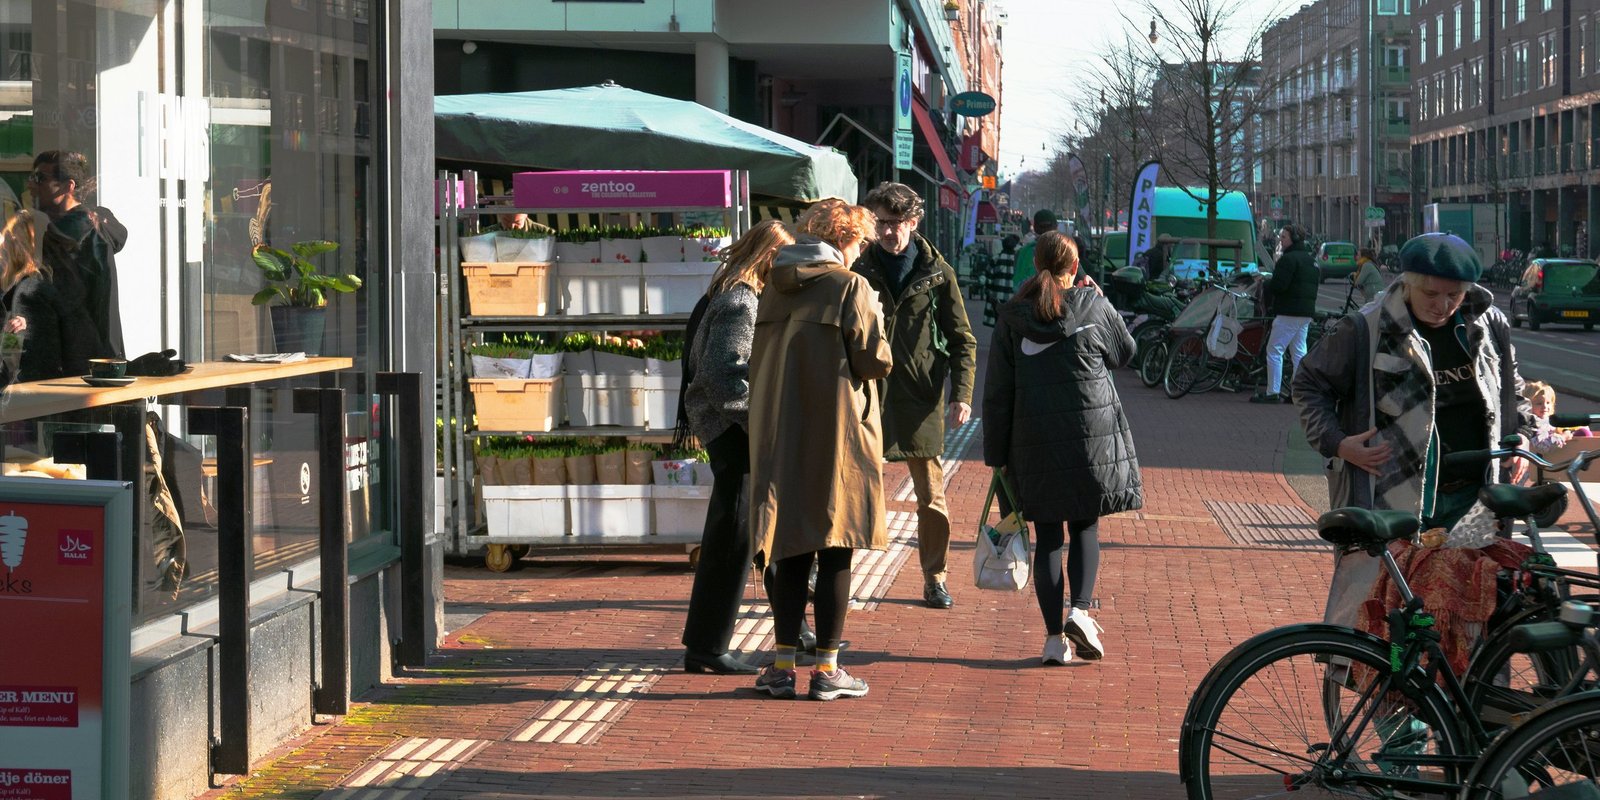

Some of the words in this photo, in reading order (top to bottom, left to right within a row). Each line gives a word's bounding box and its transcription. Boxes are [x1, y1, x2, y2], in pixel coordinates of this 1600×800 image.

[581, 181, 635, 192] zentoo
[60, 535, 91, 552] حلال
[21, 691, 75, 704] MENU
[24, 772, 69, 784] döner
